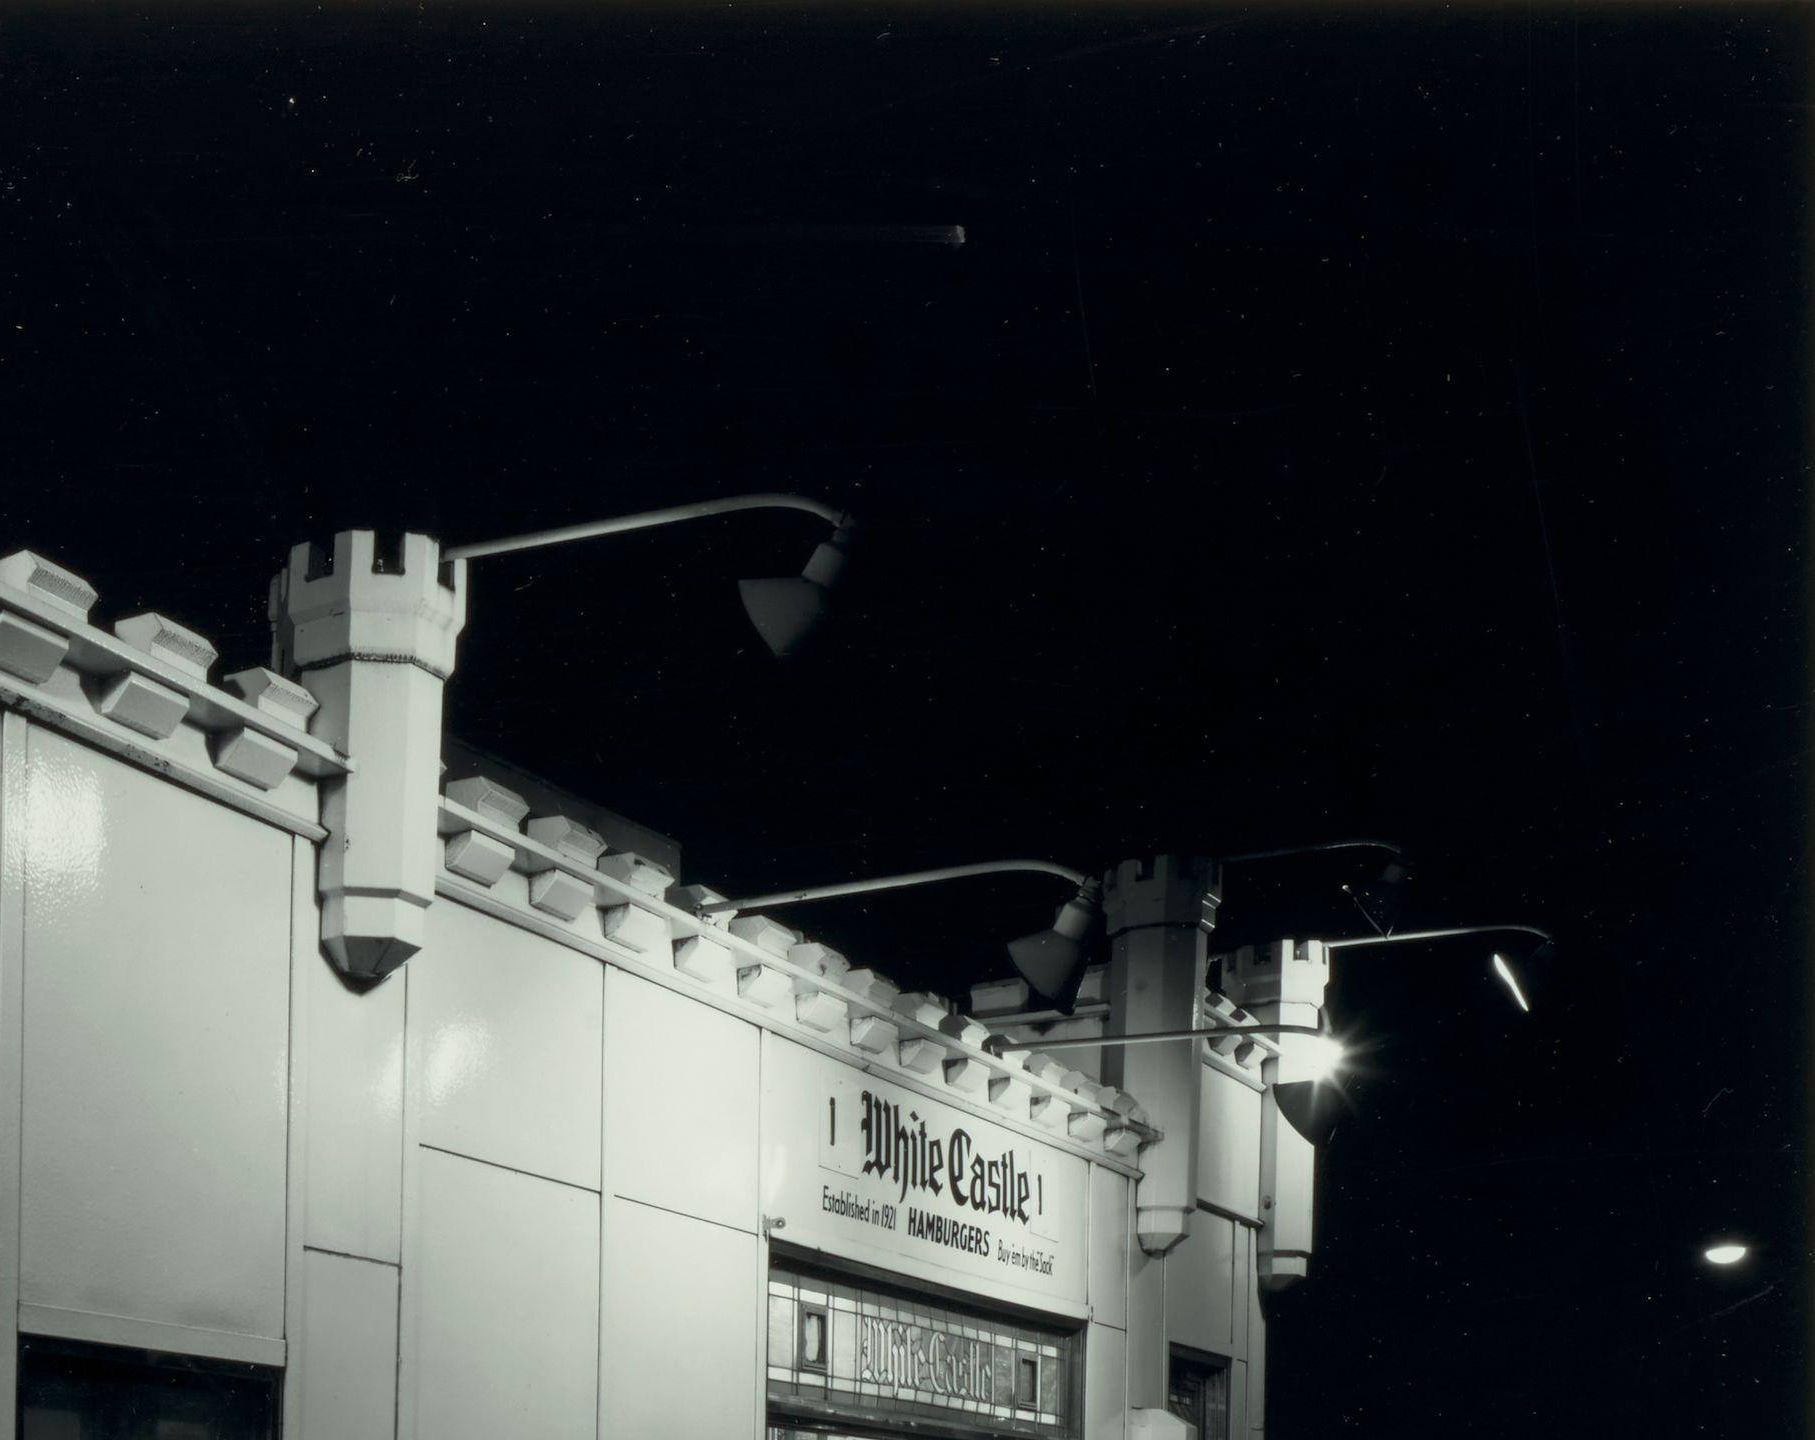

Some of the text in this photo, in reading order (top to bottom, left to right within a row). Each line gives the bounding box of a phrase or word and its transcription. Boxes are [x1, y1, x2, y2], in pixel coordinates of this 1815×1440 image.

[861, 1090, 1031, 1226] White Castle
[822, 1184, 870, 1223] Established
[872, 1200, 880, 1226] in
[881, 1203, 897, 1231] 1921
[907, 1206, 990, 1257] HAMBURGERS
[997, 1239, 1011, 1266] Buy
[1021, 1246, 1029, 1271] by
[1029, 1249, 1039, 1272] the
[929, 1331, 992, 1400] Castle
